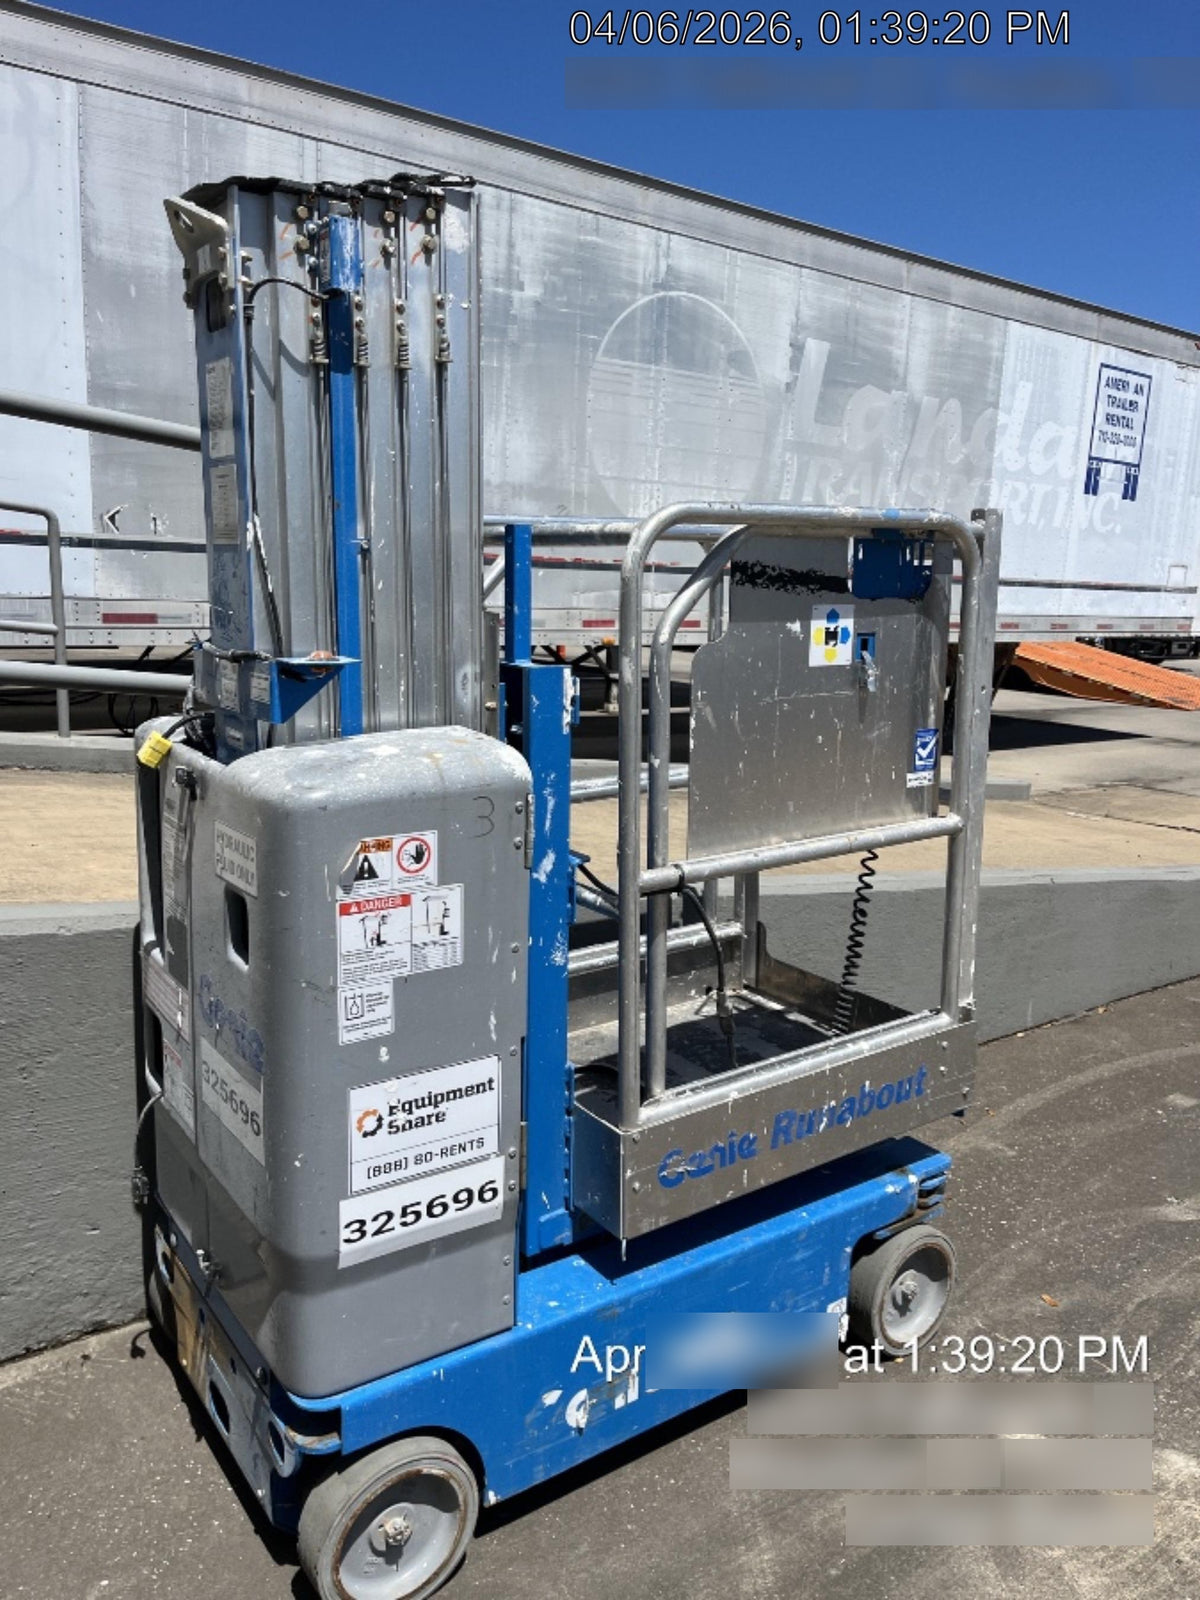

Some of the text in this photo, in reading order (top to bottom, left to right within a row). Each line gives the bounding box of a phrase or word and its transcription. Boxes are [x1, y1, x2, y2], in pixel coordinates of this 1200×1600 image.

[1104, 376, 1145, 397] AMERIAN
[473, 795, 496, 839] 3
[360, 897, 402, 911] DANGER
[201, 1060, 261, 1138] 325696
[387, 1076, 495, 1117] Equipment
[657, 1062, 928, 1188] Genie Runabout
[342, 1180, 499, 1244] 325696
